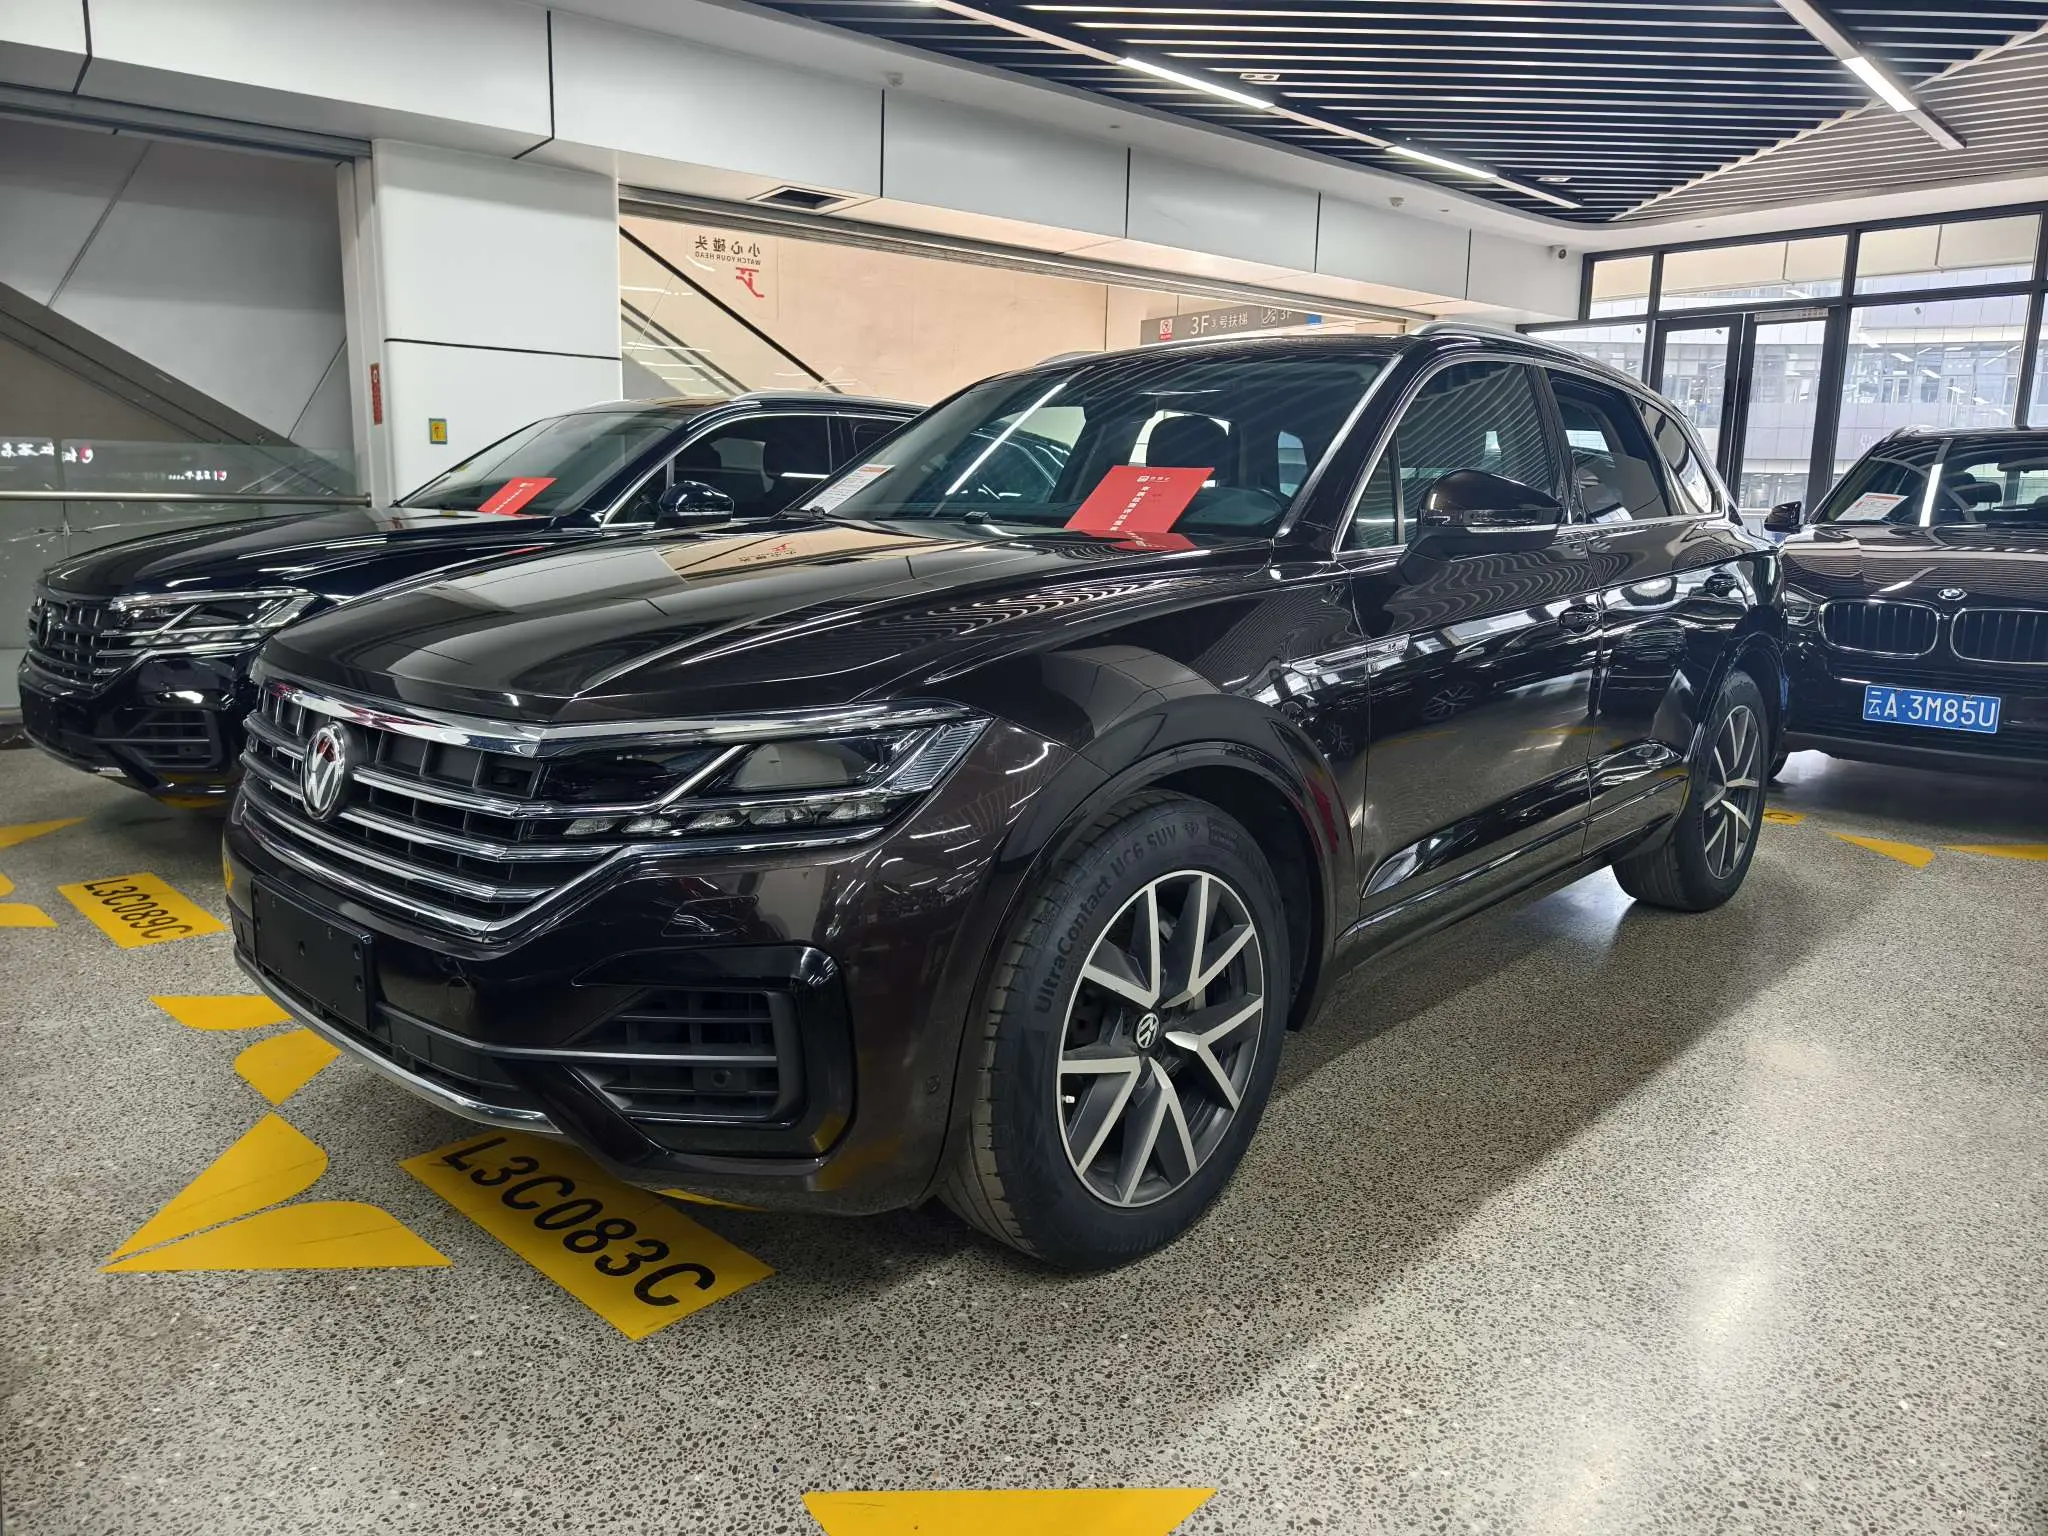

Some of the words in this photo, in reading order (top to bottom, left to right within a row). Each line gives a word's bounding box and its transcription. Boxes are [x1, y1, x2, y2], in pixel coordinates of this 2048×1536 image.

[1190, 314, 1210, 335] 3F
[1110, 843, 1145, 879] UC6
[1146, 824, 1177, 848] SUV
[83, 878, 193, 939] L3C089C
[440, 1137, 716, 1307] L3C083C
